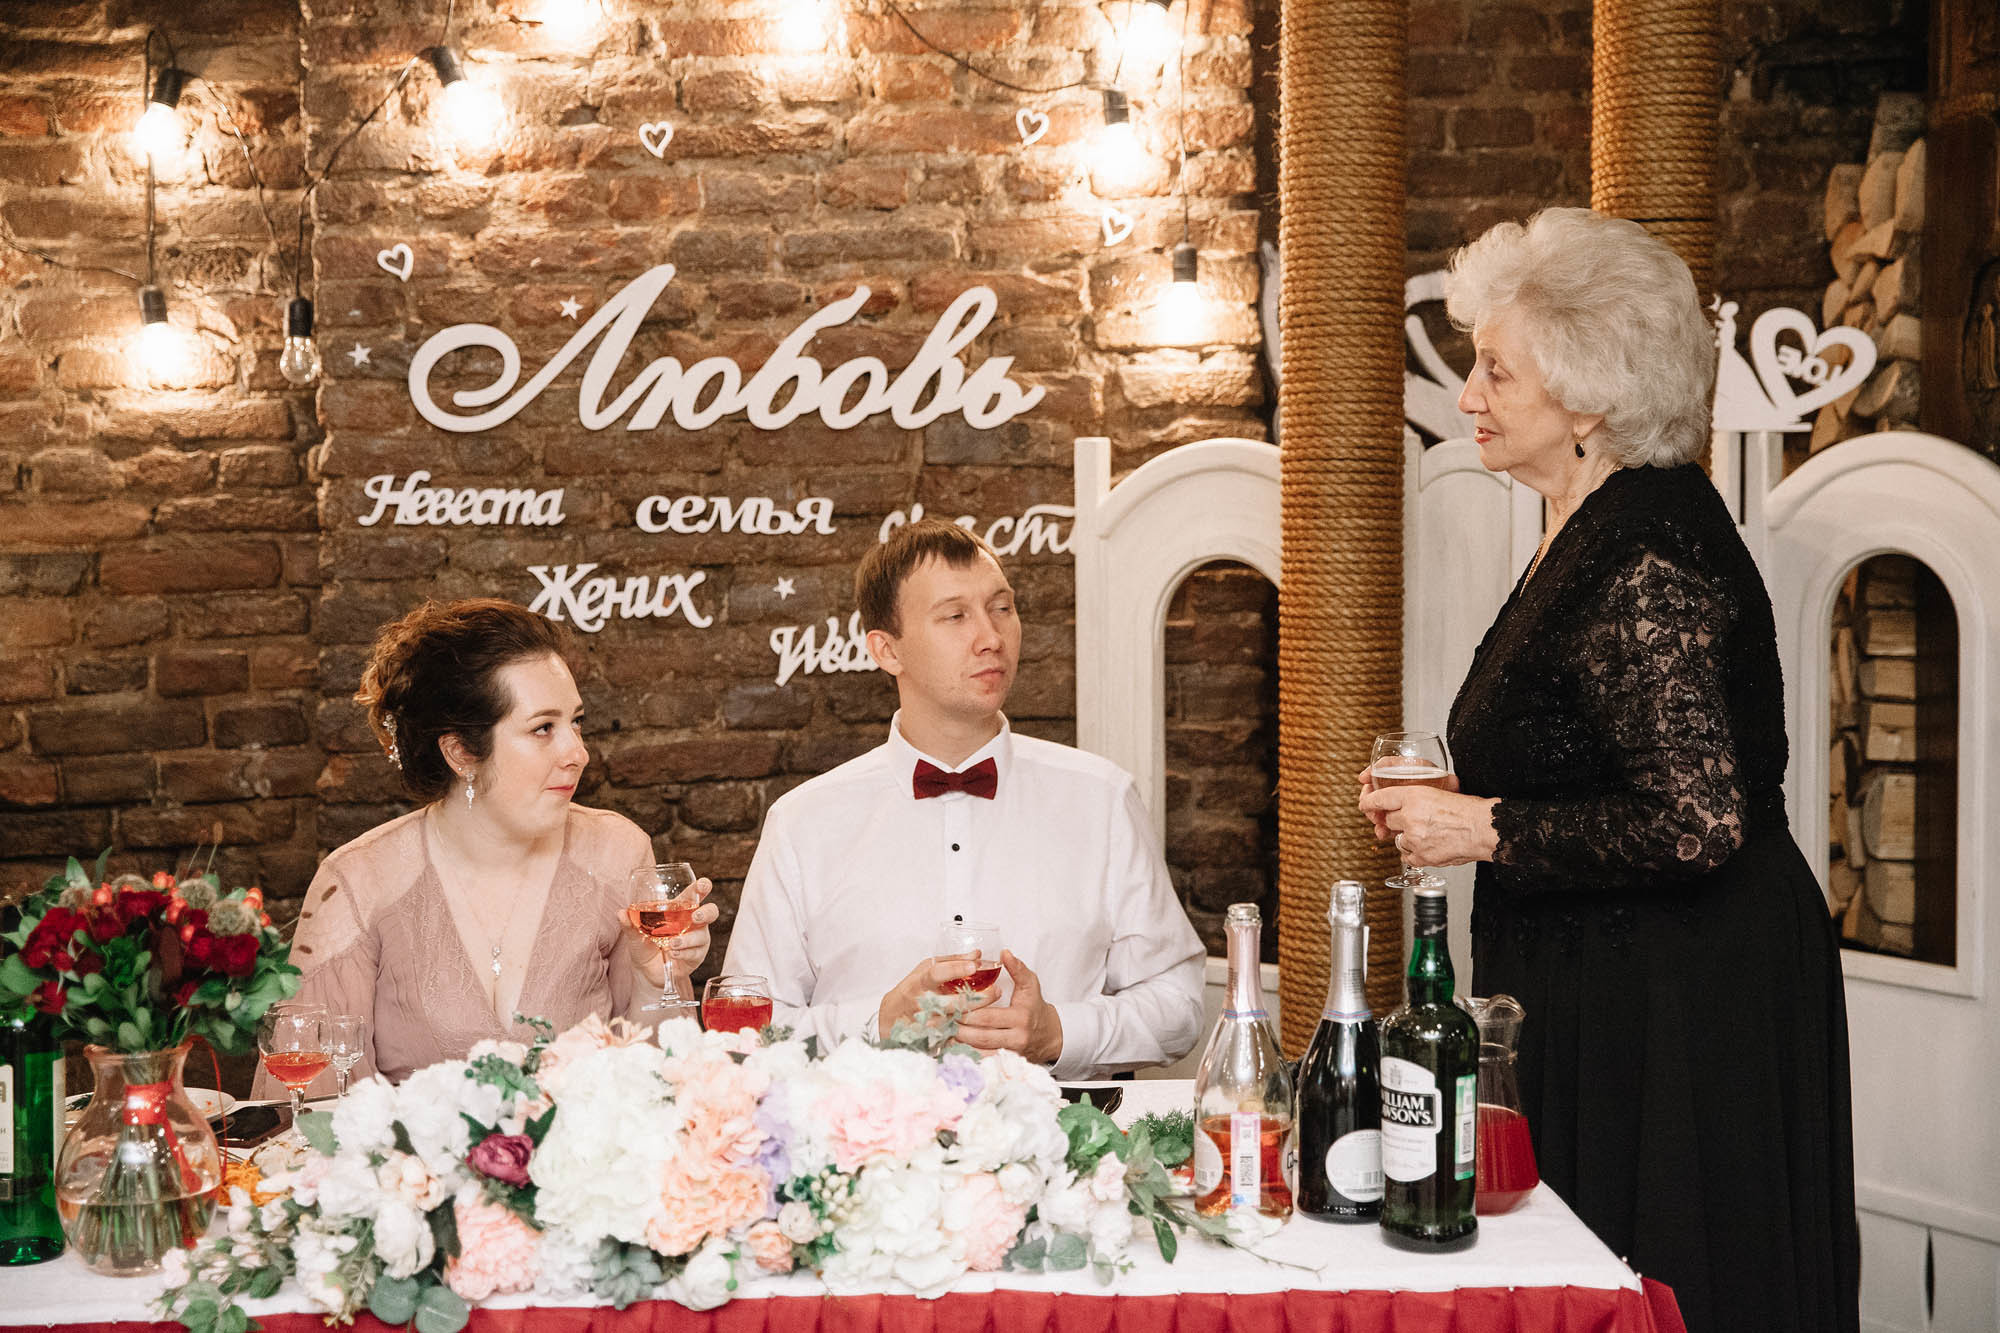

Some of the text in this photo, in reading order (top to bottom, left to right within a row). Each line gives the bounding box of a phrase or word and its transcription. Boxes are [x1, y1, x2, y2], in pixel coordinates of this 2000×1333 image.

[408, 263, 1046, 433] Любовь
[357, 470, 566, 527] Невеста
[636, 495, 836, 534] семья
[526, 563, 713, 633] Жених
